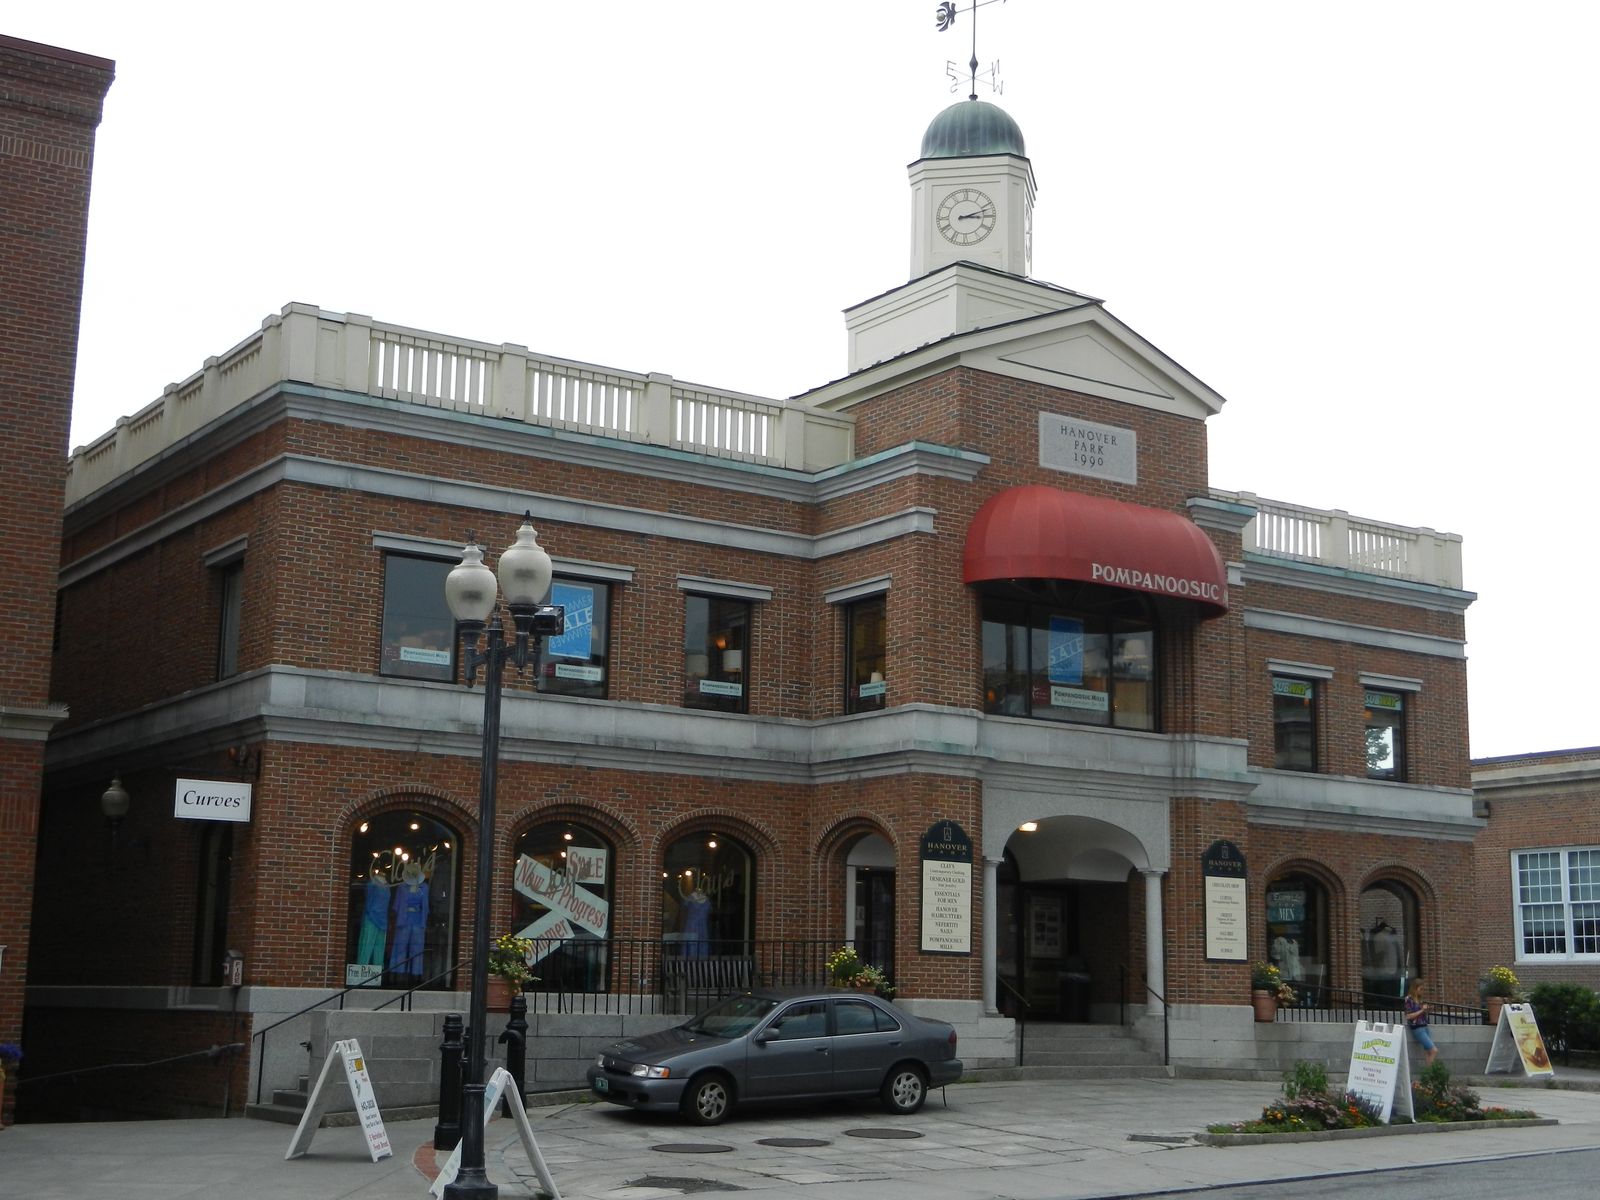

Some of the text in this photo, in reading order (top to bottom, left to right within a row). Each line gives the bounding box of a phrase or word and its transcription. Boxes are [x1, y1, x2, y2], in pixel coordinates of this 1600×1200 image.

[1060, 425, 1118, 446] HANOVER
[1074, 440, 1105, 456] PARK
[1074, 453, 1104, 467] 1990
[1091, 563, 1220, 601] POMPANOOSUC
[564, 604, 593, 626] ALE
[1273, 681, 1311, 696] SUBWAY
[1364, 692, 1400, 708] SUBWAY
[183, 790, 241, 808] Curves
[927, 841, 967, 852] HANOVER
[569, 851, 604, 880] SALE
[1208, 859, 1242, 868] HANOVER
[516, 859, 545, 894] Now
[558, 890, 606, 928] Progress
[1279, 908, 1295, 921] MEN
[347, 964, 360, 977] Free
